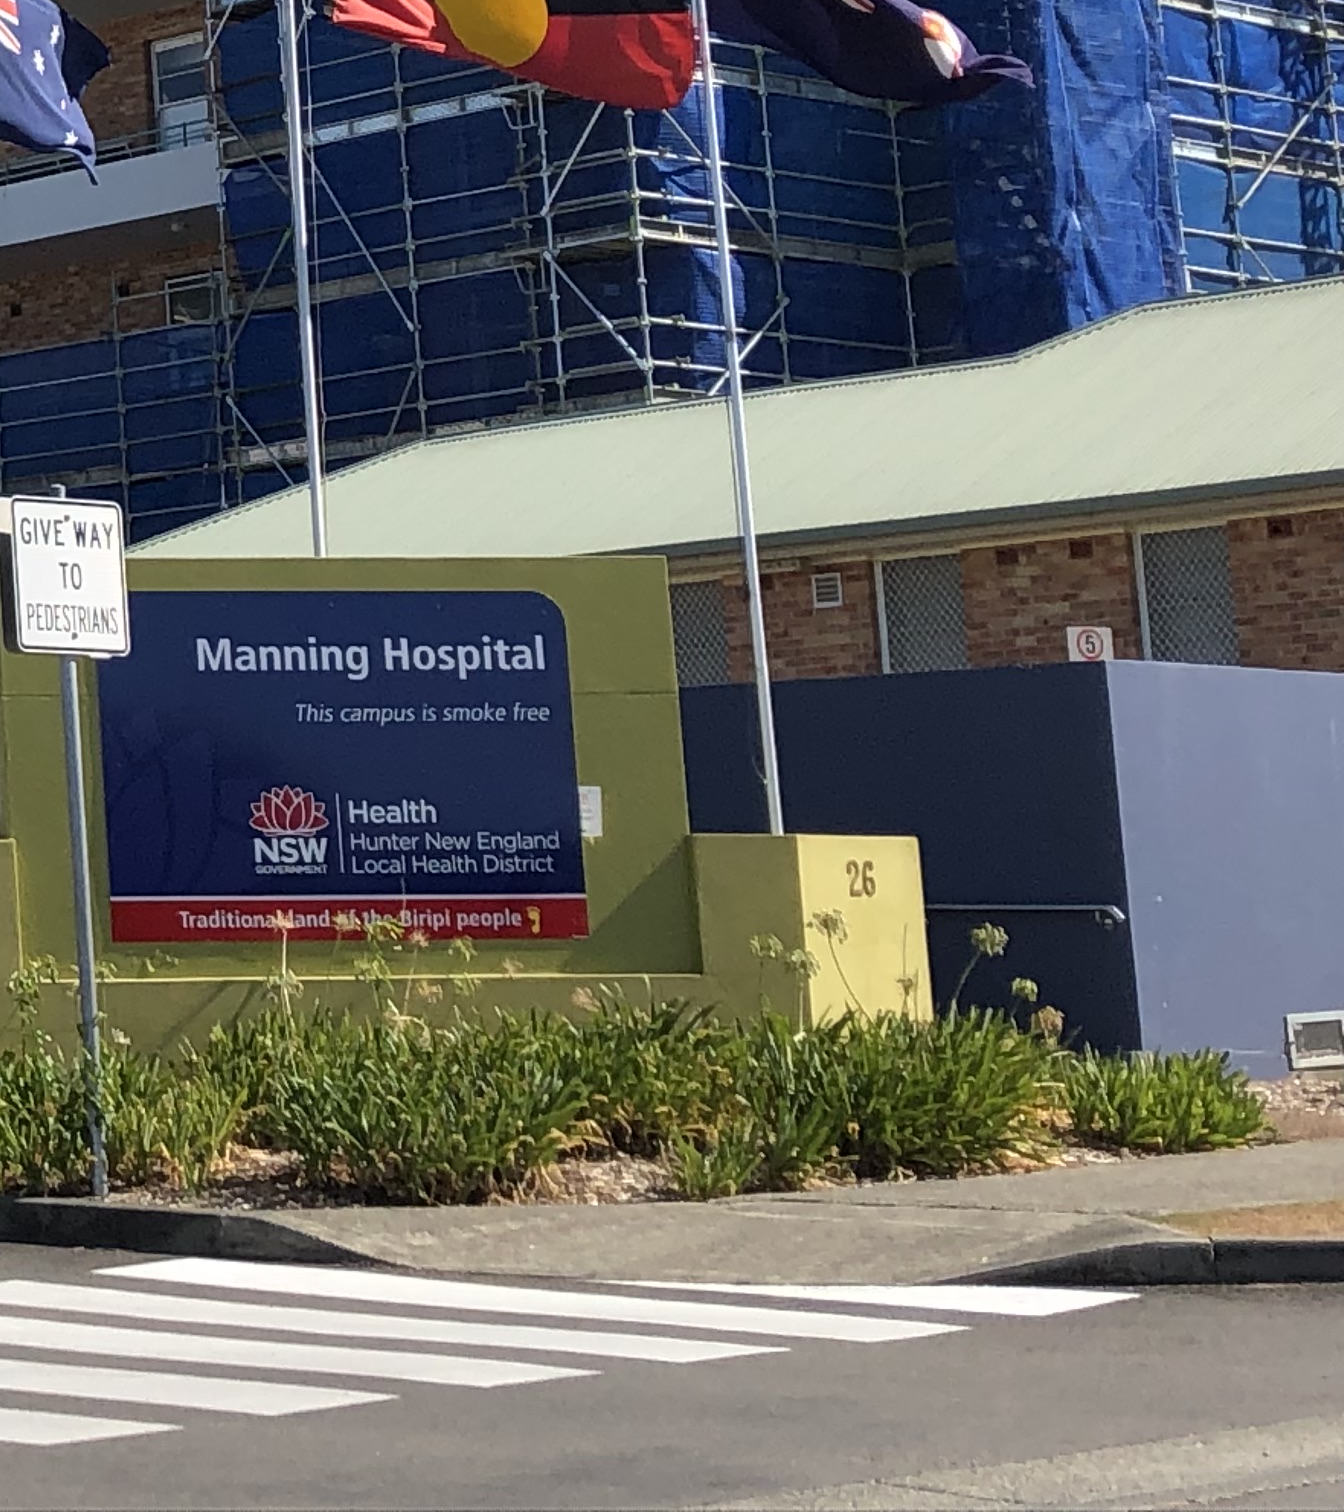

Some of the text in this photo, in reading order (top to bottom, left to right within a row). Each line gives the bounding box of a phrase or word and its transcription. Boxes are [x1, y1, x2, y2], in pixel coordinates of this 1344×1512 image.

[19, 517, 113, 550] GIVE WAY
[58, 562, 83, 590] TO
[26, 602, 119, 636] PEDESTRIANS
[1085, 634, 1096, 654] 5
[195, 634, 546, 681] Manning Hospital
[295, 701, 551, 726] This campus is smoke free
[348, 798, 438, 824] Health
[253, 837, 328, 864] NSW
[350, 830, 560, 854] Hunter New England
[351, 853, 555, 874] Local Health District
[846, 859, 877, 898] 26
[179, 908, 282, 929] Traditiona
[456, 907, 523, 931] people
